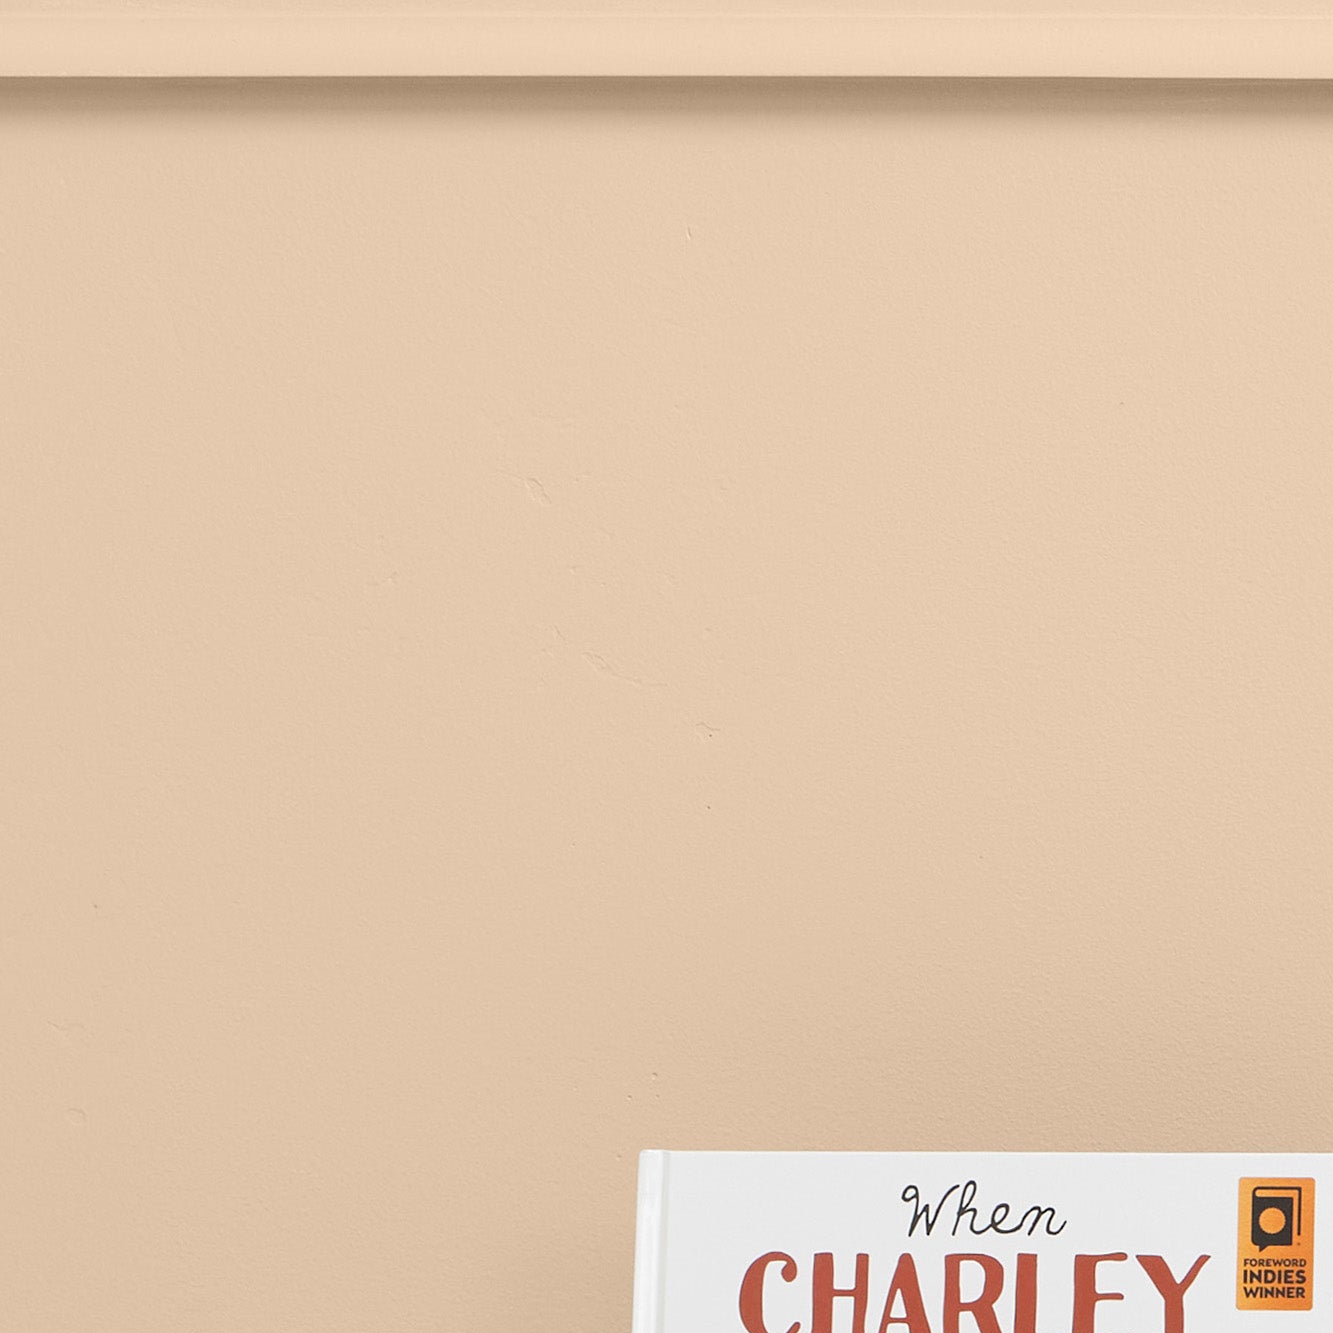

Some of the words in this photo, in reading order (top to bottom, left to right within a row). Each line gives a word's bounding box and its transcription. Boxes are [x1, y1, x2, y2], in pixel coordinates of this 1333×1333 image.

[902, 1180, 1068, 1238] When
[1243, 1258, 1307, 1267] FOREWORD
[1243, 1269, 1307, 1284] INDIES
[1243, 1286, 1306, 1299] WINNER
